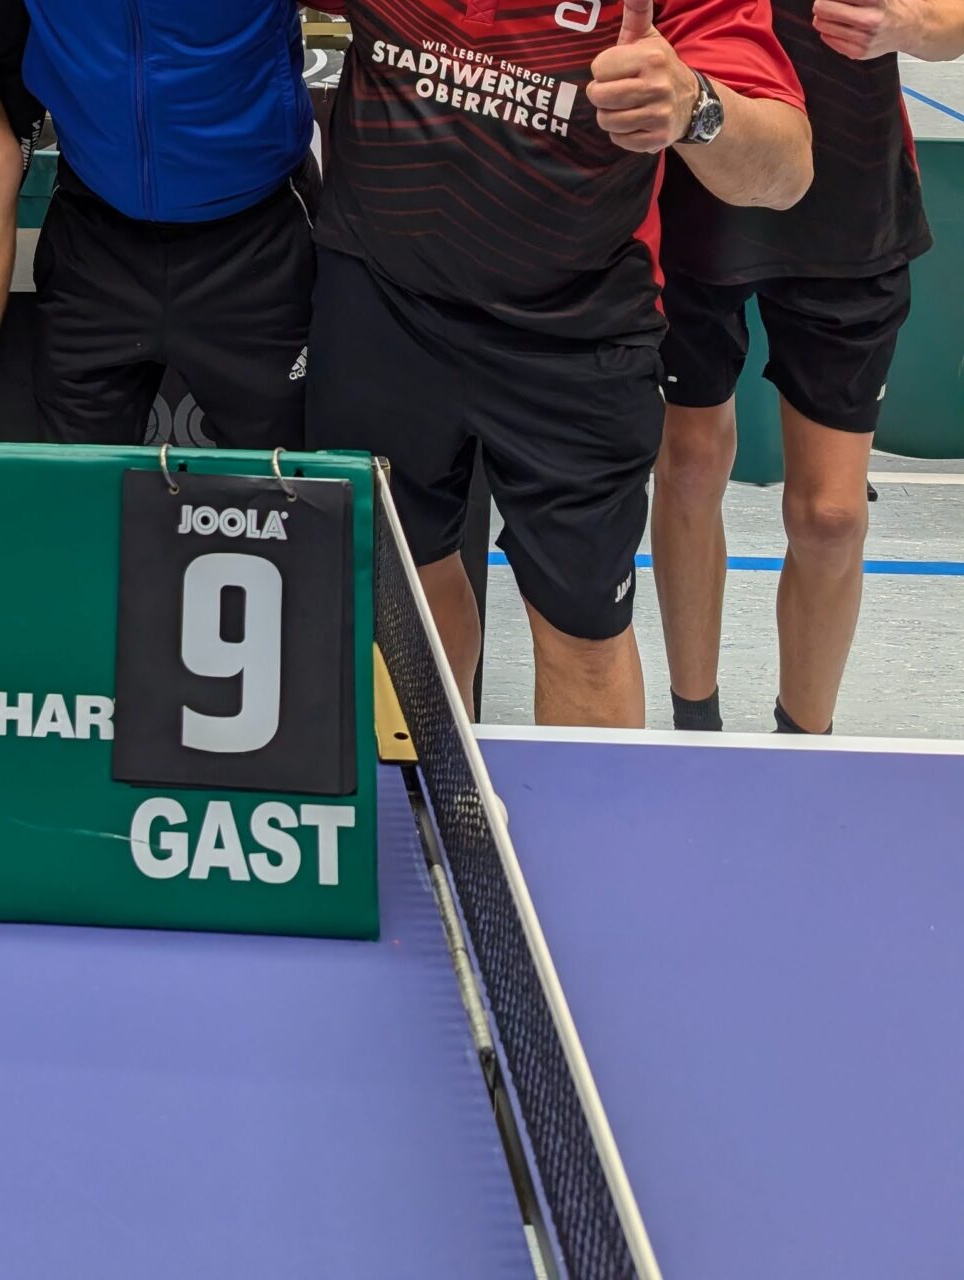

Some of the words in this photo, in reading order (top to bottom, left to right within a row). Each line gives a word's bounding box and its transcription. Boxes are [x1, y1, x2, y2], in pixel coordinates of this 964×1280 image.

[371, 40, 552, 112] STADTWERKE
[422, 39, 448, 54] WIR
[452, 46, 494, 66] LEBEN
[500, 60, 556, 89] ENERGIE
[415, 78, 569, 137] OBERKIRCH
[178, 505, 288, 541] JOOLA
[181, 552, 283, 753] 9
[129, 796, 356, 886] GAST
